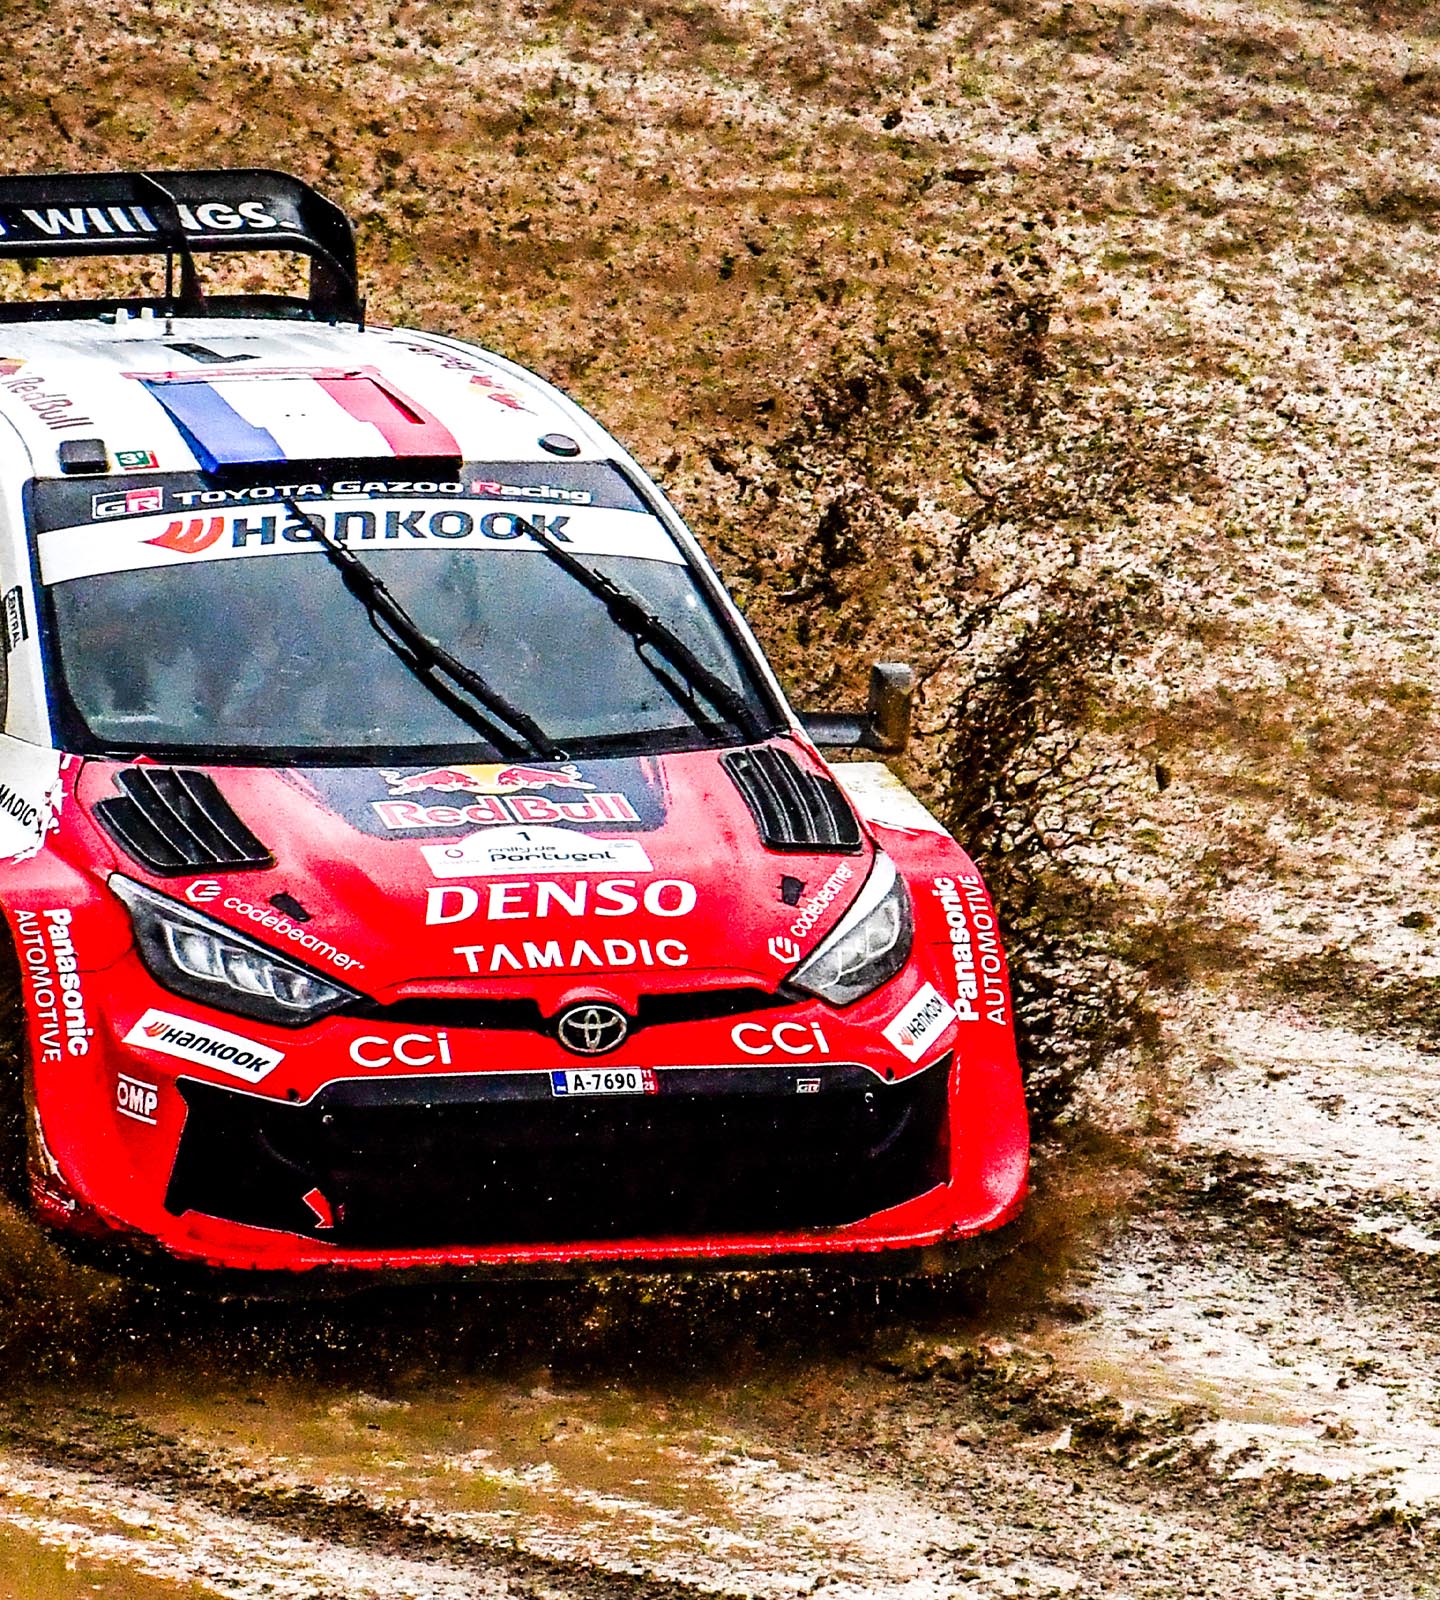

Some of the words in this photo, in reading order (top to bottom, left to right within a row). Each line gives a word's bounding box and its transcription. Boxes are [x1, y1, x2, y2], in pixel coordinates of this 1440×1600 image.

[1, 377, 67, 401] Red
[29, 399, 94, 429] Bull
[95, 496, 161, 516] GR
[172, 484, 323, 505] TOYOTA
[332, 480, 464, 494] GAZOO
[471, 480, 592, 504] Racing
[375, 796, 510, 828] Red
[510, 793, 638, 823] Bull
[516, 831, 531, 841] 1
[491, 851, 616, 862] Portugal
[426, 879, 698, 925] DENSO
[790, 861, 855, 938] codebeamer
[223, 896, 361, 971] codebeamer
[932, 876, 979, 1022] Panasonic
[957, 874, 1007, 1025] AUTOMOTIVE
[453, 939, 689, 973] TAMADIC
[14, 909, 62, 1063] AUTOMOTIVE
[43, 908, 95, 1057] Panasonic
[116, 1081, 158, 1116] OMP
[574, 1073, 636, 1091] A-7690
